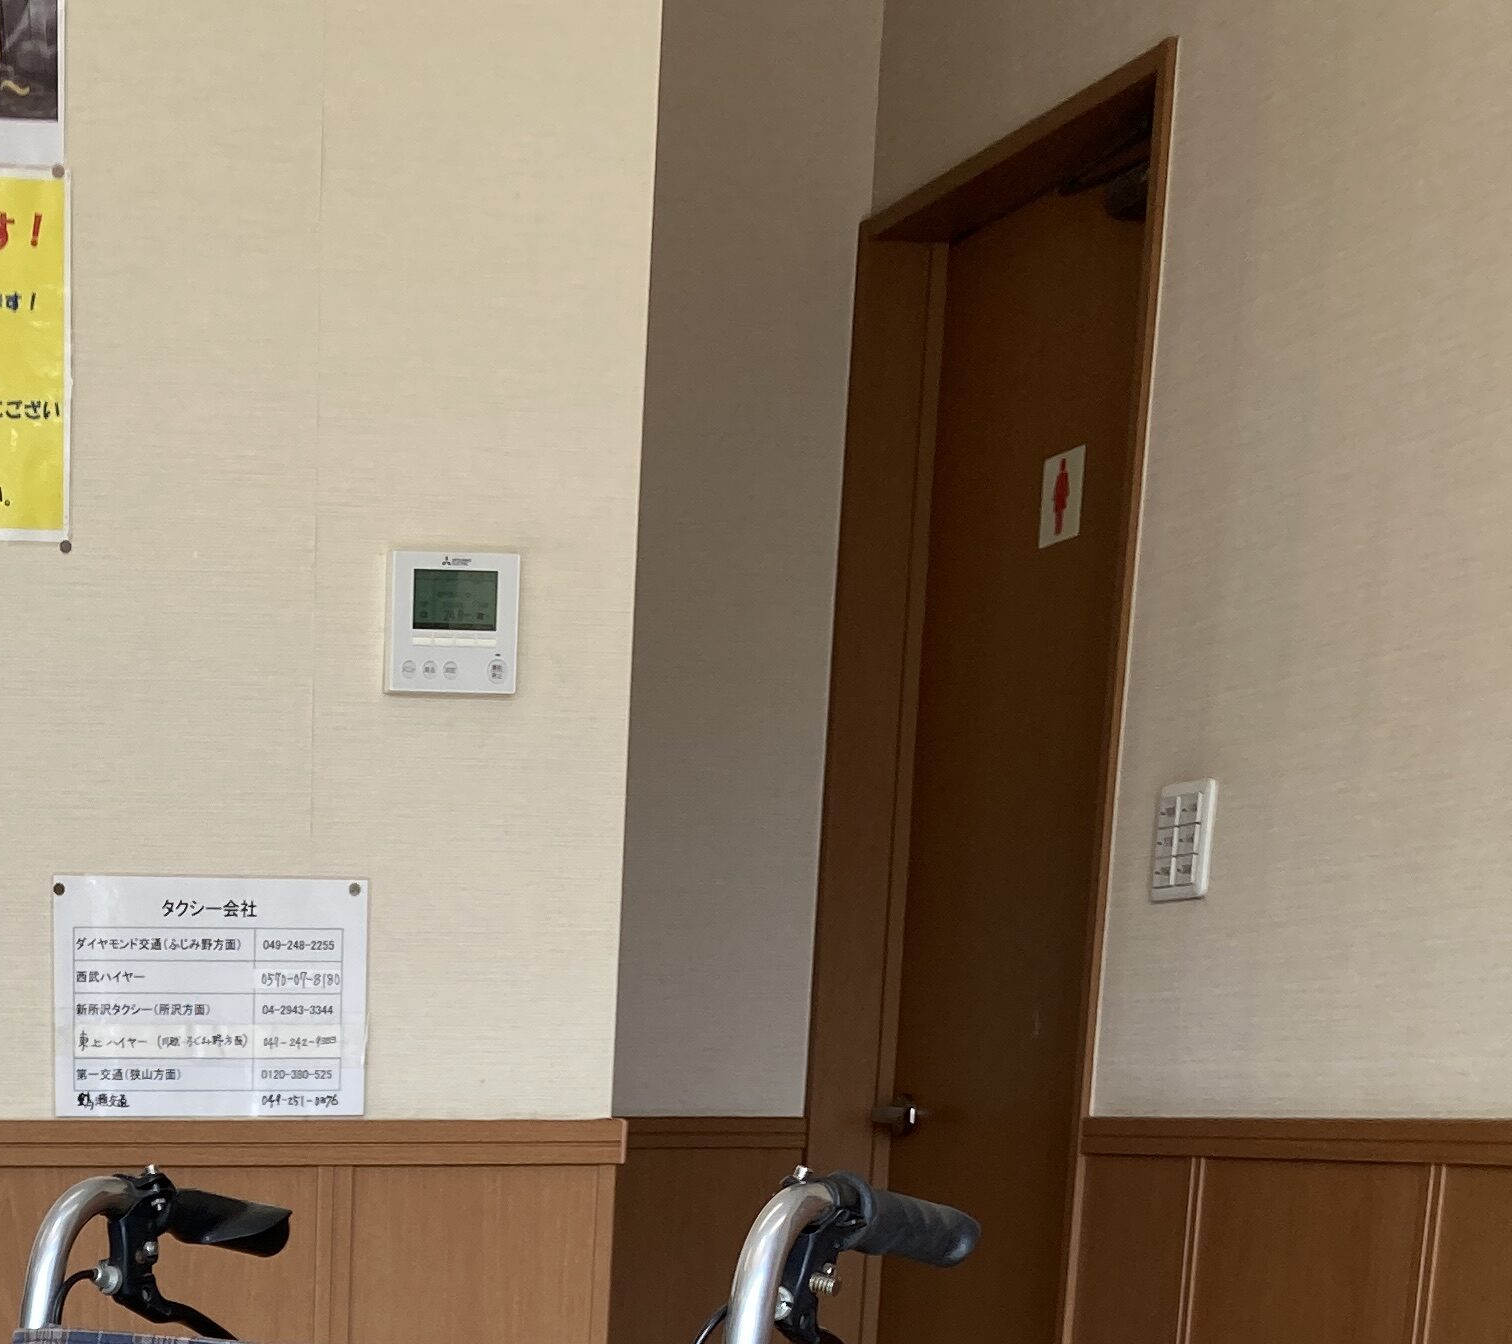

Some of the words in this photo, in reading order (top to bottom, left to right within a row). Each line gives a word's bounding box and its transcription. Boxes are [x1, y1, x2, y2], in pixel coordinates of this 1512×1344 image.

[161, 899, 258, 918] タクシー会社
[75, 937, 242, 952] ダイヤモンド交通（ふじみ野方面）
[262, 939, 335, 951] 049-248-2255
[75, 970, 146, 983] 西武ハイヤー
[76, 1003, 211, 1017] 新所沢タクシー（所沢方面）
[76, 1068, 182, 1082] 第一交通（狭山方面）
